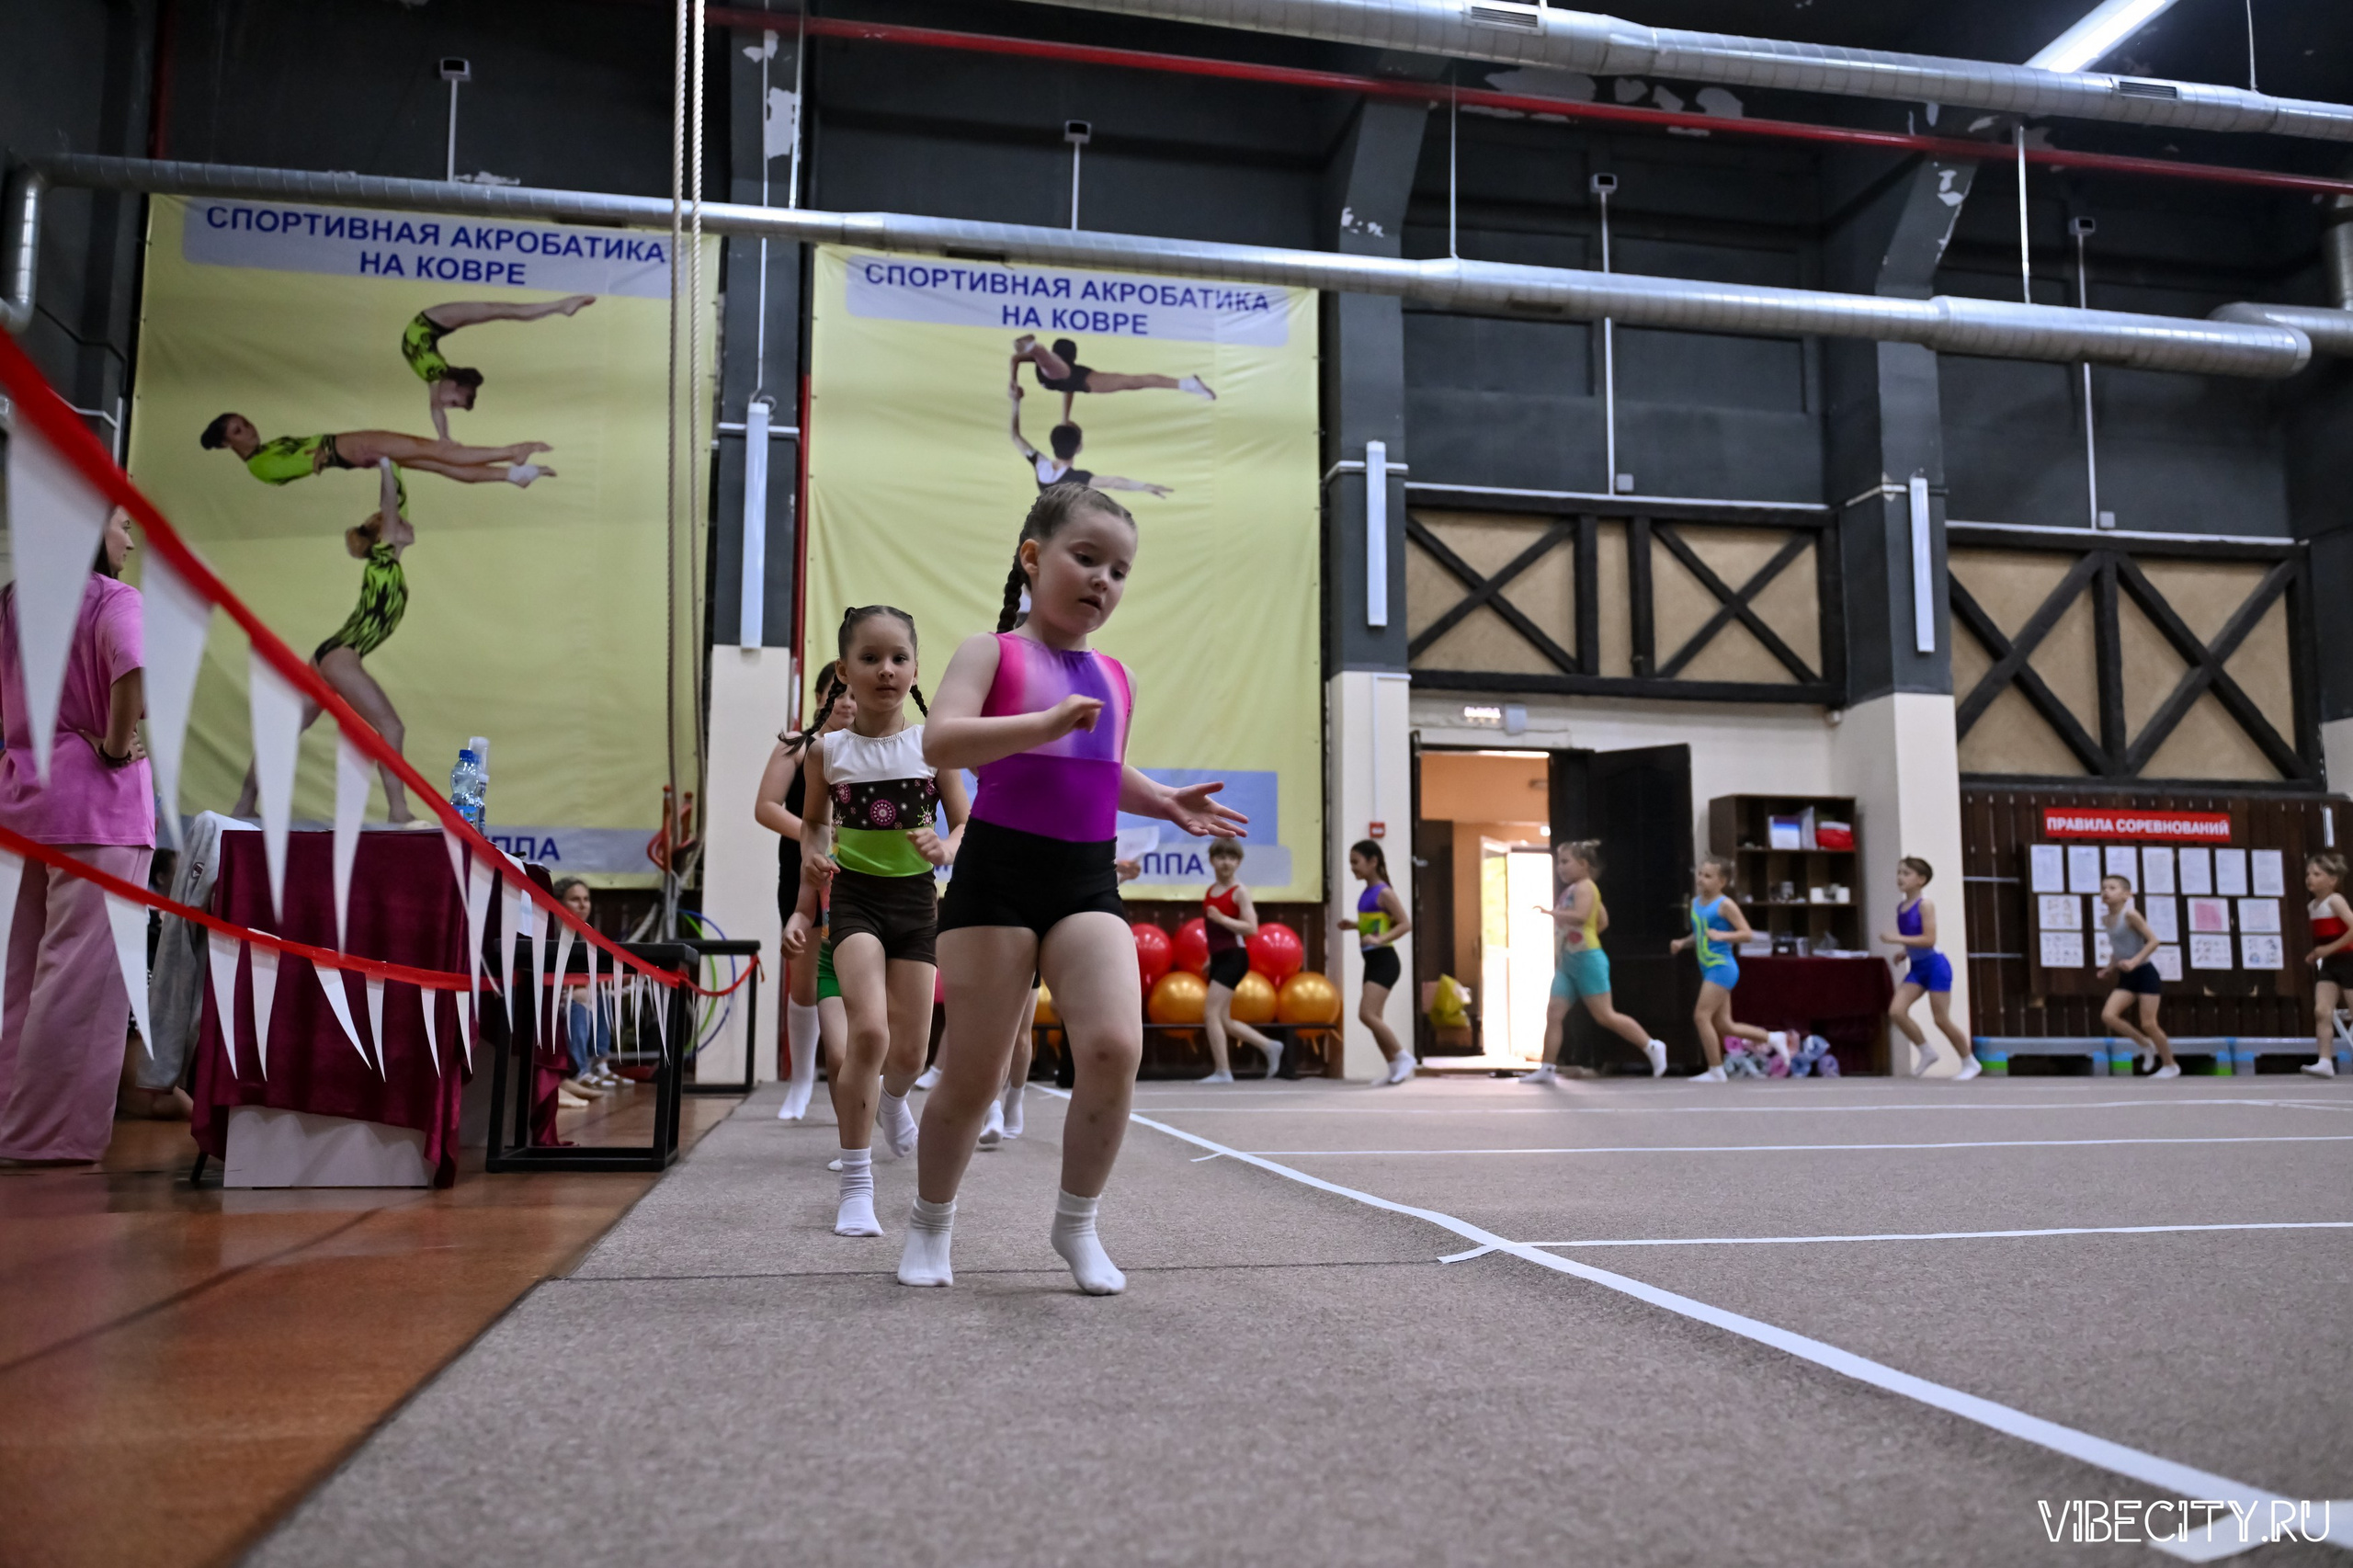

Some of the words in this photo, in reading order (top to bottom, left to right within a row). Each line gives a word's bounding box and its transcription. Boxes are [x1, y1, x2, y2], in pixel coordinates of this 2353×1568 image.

[207, 206, 440, 246] СПОРТИВНАЯ
[449, 225, 666, 263] АКРОБАТИКА
[359, 250, 405, 276] НА
[416, 256, 527, 285] КОВРЕ
[865, 263, 1072, 300] СПОРТИВНАЯ
[1081, 280, 1270, 313] АКРОБАТИКА
[1002, 304, 1042, 328] НА
[1052, 310, 1149, 335] КОВРЕ
[2046, 816, 2114, 832] ПРАВИЛА
[2116, 818, 2229, 835] СОРЕВНОВАНИЙ
[485, 835, 561, 861] ППА
[1143, 853, 1204, 875] ППА
